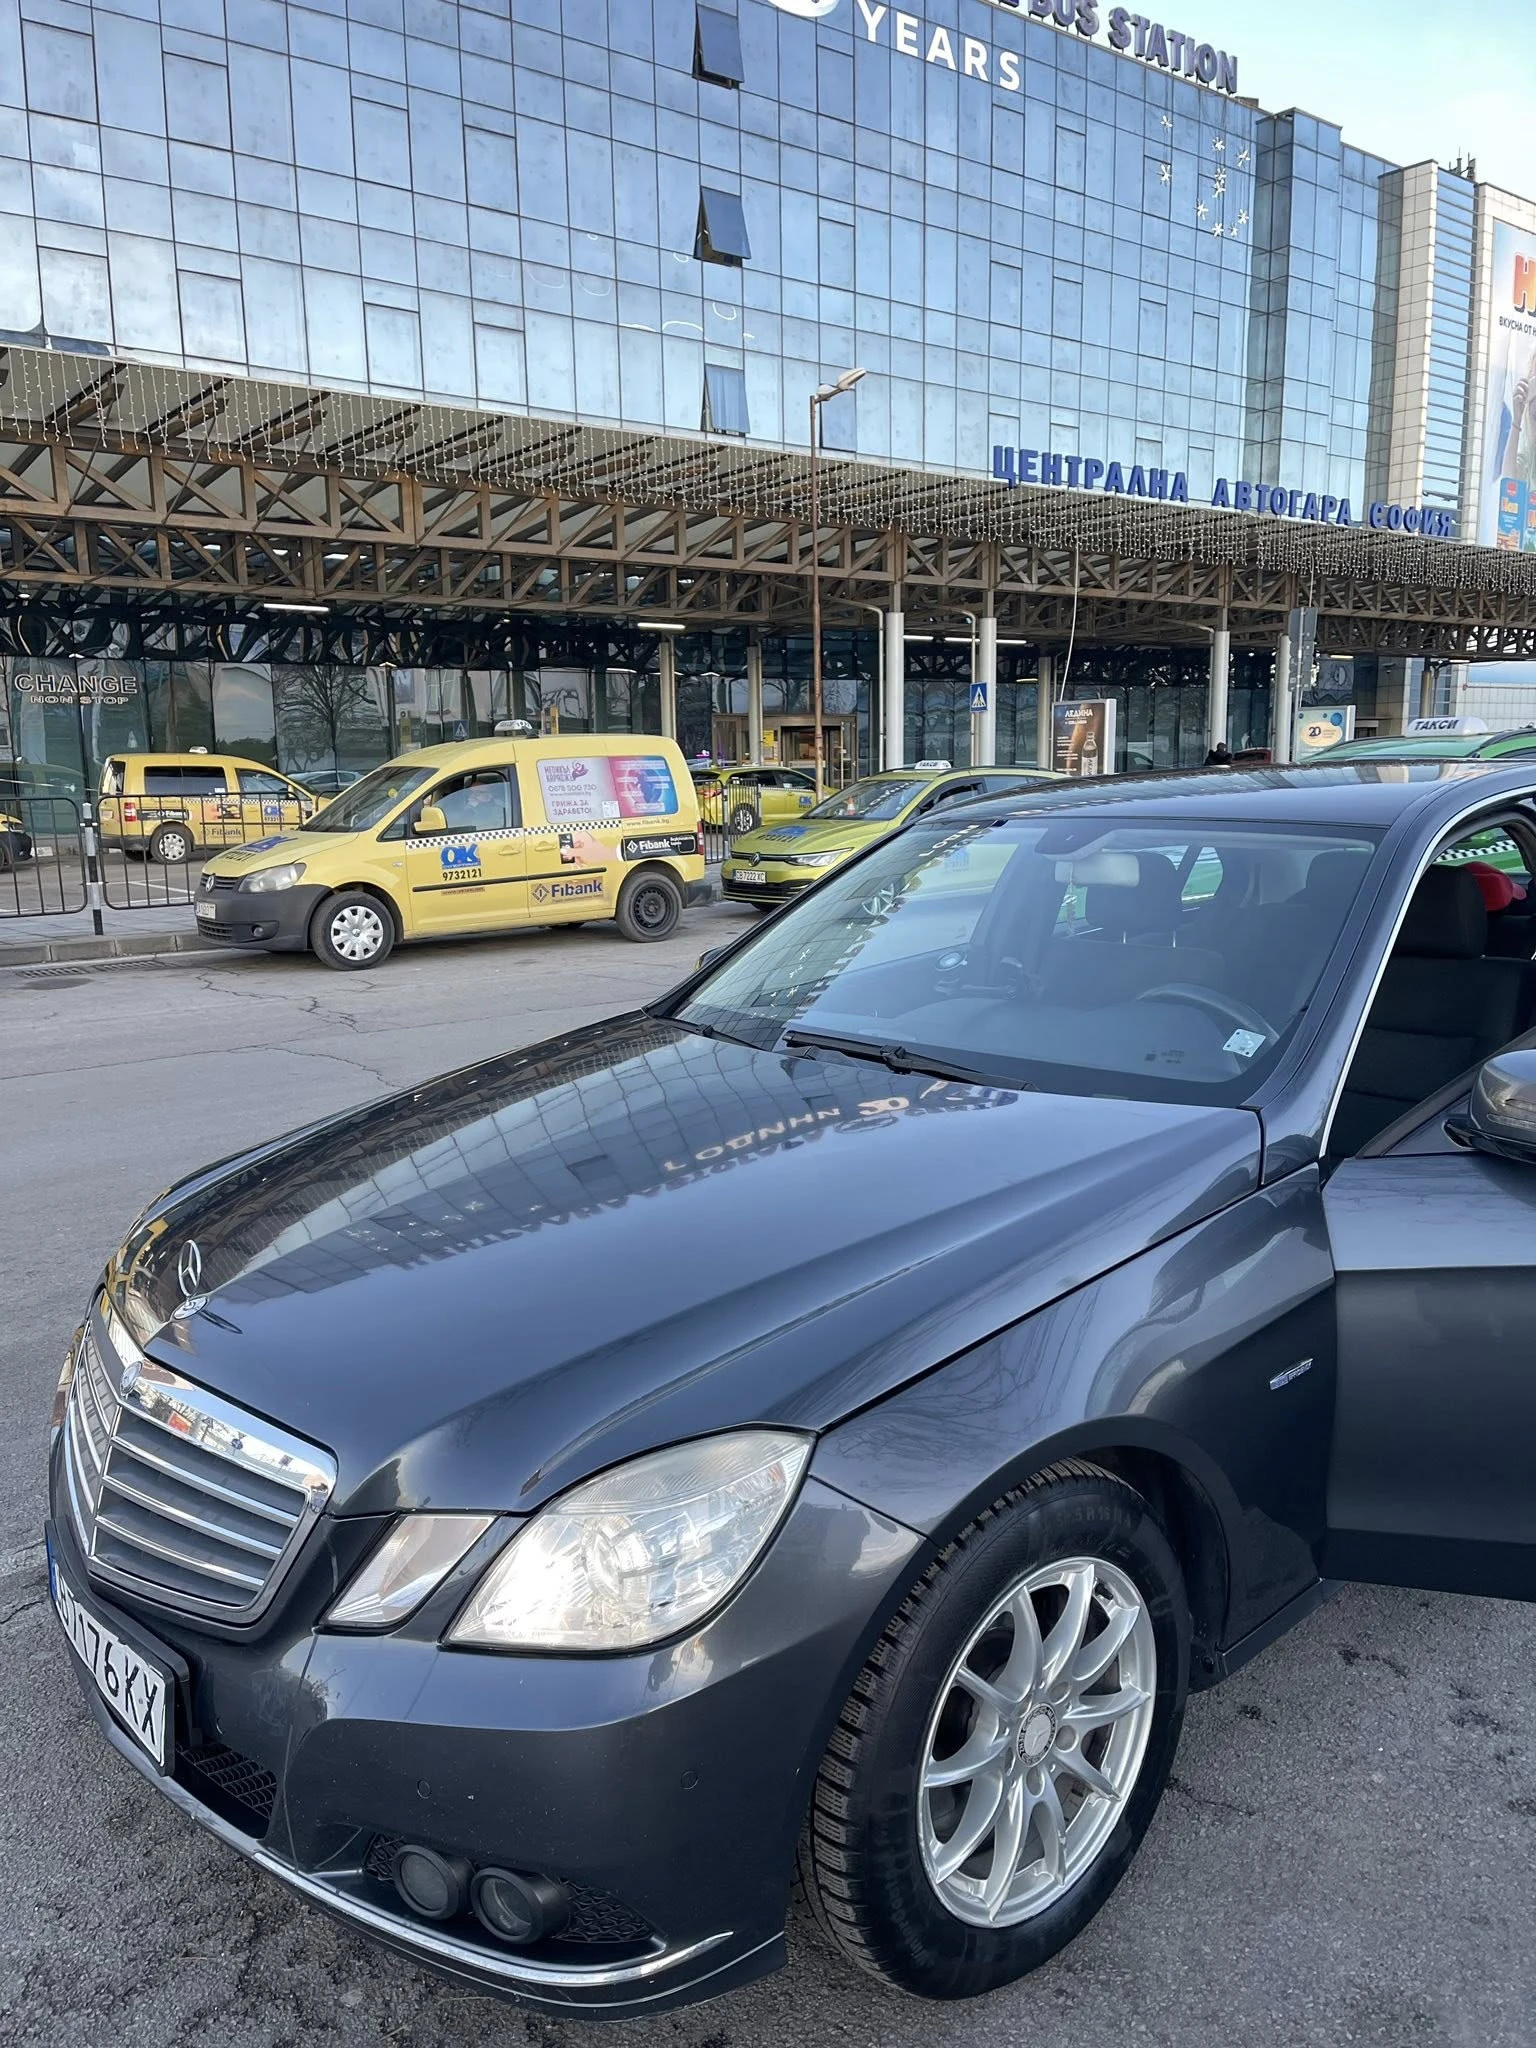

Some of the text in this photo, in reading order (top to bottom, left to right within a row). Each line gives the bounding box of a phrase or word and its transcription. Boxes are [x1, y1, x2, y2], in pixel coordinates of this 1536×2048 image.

[857, 0, 1020, 90] YEARS
[1108, 6, 1238, 95] STATION
[993, 445, 1452, 537] ЦЕНТРАЛНА АВТОГАРА СОФИЯ
[14, 674, 138, 694] CHANGE
[30, 695, 129, 705] NON STOP
[1065, 708, 1093, 718] ЛЕДИНА
[1309, 726, 1322, 737] 20
[1414, 719, 1460, 731] ТАКСИ
[639, 838, 671, 851] Fibank
[440, 843, 481, 866] OK
[442, 868, 482, 881] 9732121
[551, 880, 603, 898] Fibank
